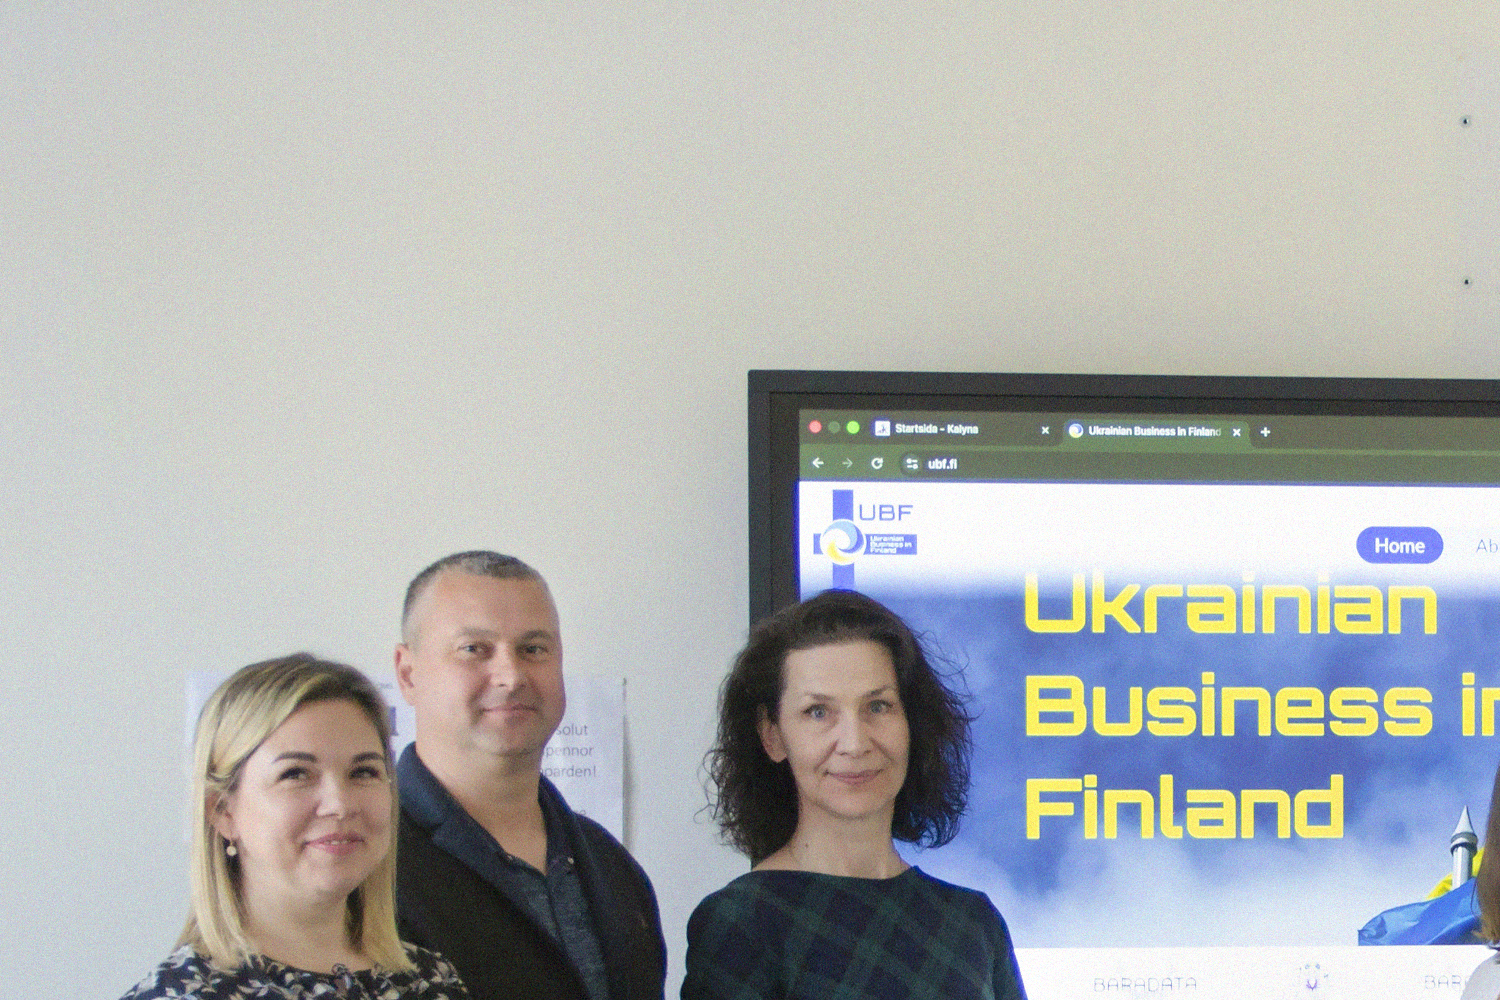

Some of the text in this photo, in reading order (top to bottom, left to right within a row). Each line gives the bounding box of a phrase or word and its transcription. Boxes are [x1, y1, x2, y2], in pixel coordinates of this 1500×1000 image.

[895, 423, 938, 434] Startsida
[947, 423, 979, 436] Kalyna
[1088, 425, 1133, 436] Ukrainian
[1133, 426, 1176, 437] Business
[1177, 426, 1186, 437] in
[928, 458, 958, 470] ubf.fi
[859, 504, 914, 521] UBF
[1374, 537, 1425, 554] Home
[1025, 570, 1437, 635] Ukrainian
[1026, 671, 1433, 737] Business
[1026, 774, 1344, 840] Finland
[1094, 976, 1197, 993] BARADATA
